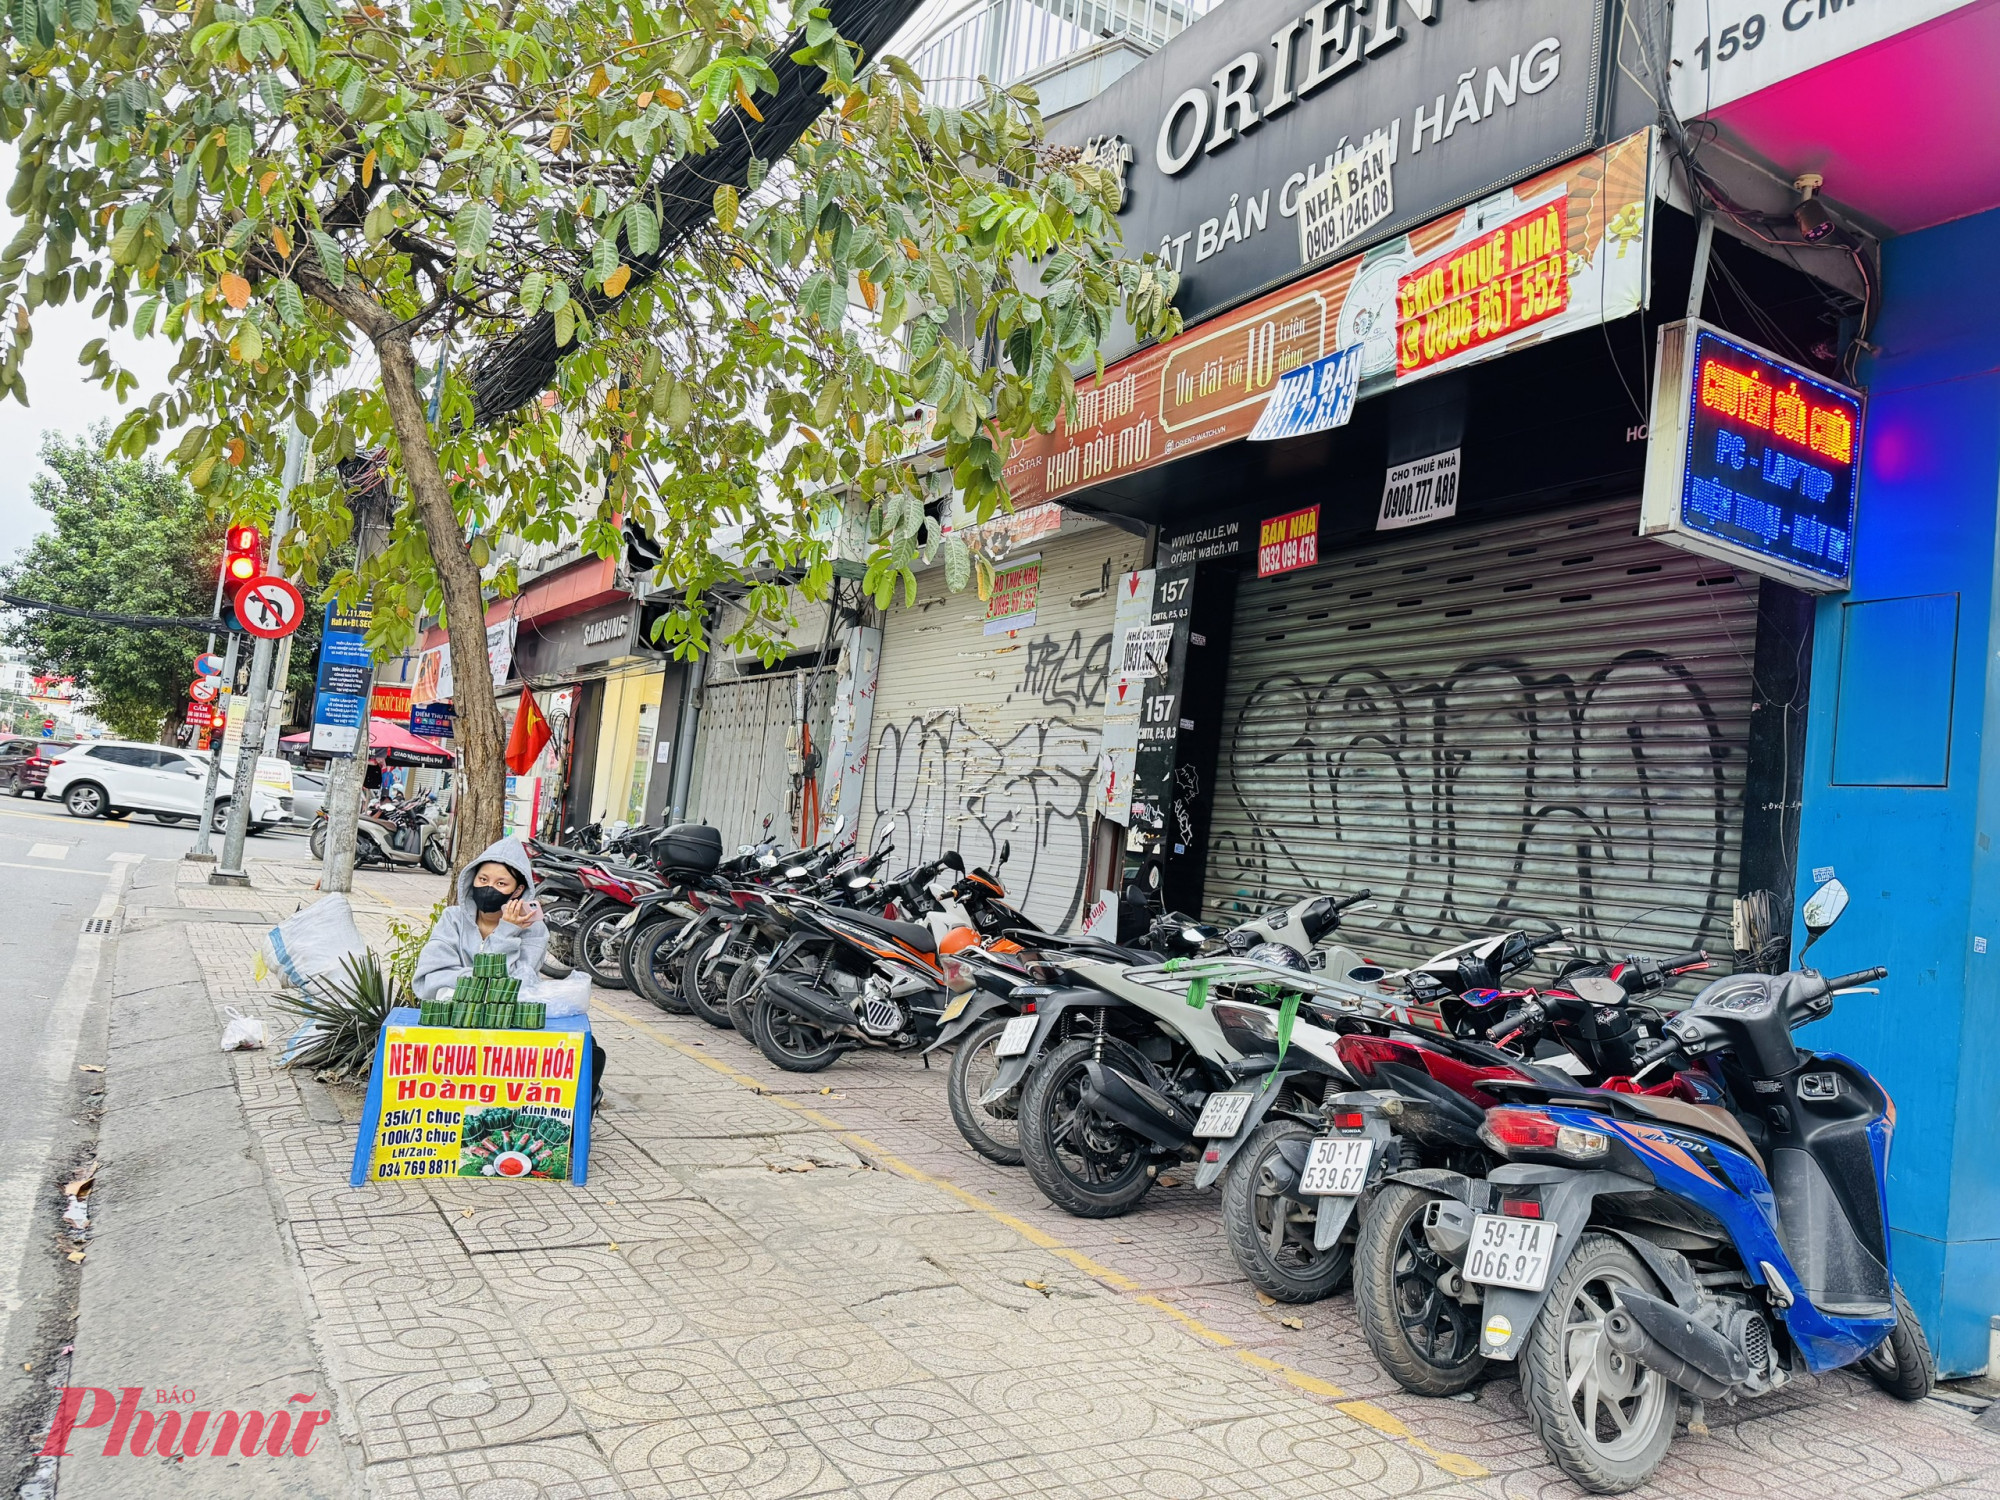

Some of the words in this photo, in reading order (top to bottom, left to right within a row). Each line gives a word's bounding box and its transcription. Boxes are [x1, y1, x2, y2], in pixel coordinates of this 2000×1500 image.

[1694, 14, 1766, 71] 159
[1196, 188, 1271, 263] BẢN
[1412, 37, 1561, 153] HÃNG
[1305, 174, 1342, 226] NHÀ
[1348, 148, 1384, 198] BÁN
[1306, 180, 1388, 261] 0909.1246.08
[1401, 267, 1446, 319] CHO
[1450, 230, 1506, 291] THUÊ
[1511, 206, 1562, 270] NHÀ
[1424, 303, 1473, 360] 0896
[1478, 279, 1512, 339] 661
[1521, 254, 1562, 320] 552
[1280, 316, 1306, 342] triệu
[1175, 371, 1194, 407] Ưu
[1199, 355, 1223, 397] đãi
[1228, 357, 1244, 387] tới
[1244, 321, 1275, 395] 10
[1271, 364, 1314, 408] NHÀ
[1318, 347, 1365, 396] BÁN
[1065, 387, 1099, 436] ĂM
[1103, 365, 1136, 423] MỚI
[1252, 382, 1356, 439] 0931.72.63.63
[1046, 437, 1080, 493] KHỞI
[1083, 421, 1114, 480] ĐẦU
[1118, 411, 1152, 469] MỚI
[1716, 428, 1746, 470] PC
[1762, 447, 1833, 504] LAPTOP
[1391, 469, 1409, 482] CHO
[1412, 460, 1434, 478] THUÊ
[1436, 455, 1457, 473] NHÀ
[1384, 471, 1457, 519] 0908.777.488
[1171, 522, 1239, 548] WWW.GALLE.VN
[1261, 519, 1285, 547] BÁN
[1290, 508, 1317, 538] NHÀ
[1171, 546, 1196, 564] orient
[1198, 538, 1239, 559] watch.vn
[1260, 547, 1281, 574] 0932
[1282, 542, 1298, 569] 099
[1299, 535, 1317, 564] 478
[993, 574, 1004, 594] HO
[1160, 578, 1189, 604] 157
[583, 615, 628, 646] SAMSUNG
[1142, 630, 1154, 641] CHO
[1146, 695, 1175, 722] 157
[389, 1043, 427, 1077] NEM
[432, 1044, 477, 1077] CHUA
[482, 1046, 539, 1079] THANH
[541, 1040, 575, 1080] HÓA
[397, 1078, 497, 1103] Hoàng
[507, 1081, 562, 1104] Văn
[384, 1108, 422, 1127] 35k/1
[426, 1108, 461, 1128] chục
[521, 1104, 548, 1116] Kính
[550, 1105, 572, 1119] Mời
[381, 1128, 423, 1147] 100k/3
[425, 1127, 457, 1147] chục
[392, 1146, 437, 1159] LH/Zalo:
[1638, 1129, 1710, 1153] VISION
[378, 1161, 401, 1178] 034
[404, 1160, 426, 1177] 769
[428, 1159, 457, 1175] 8811
[1316, 1142, 1362, 1166] 50-Y1
[1304, 1166, 1364, 1191] 539.67
[1482, 1220, 1540, 1253] 59-TA
[1469, 1244, 1542, 1285] 066.97
